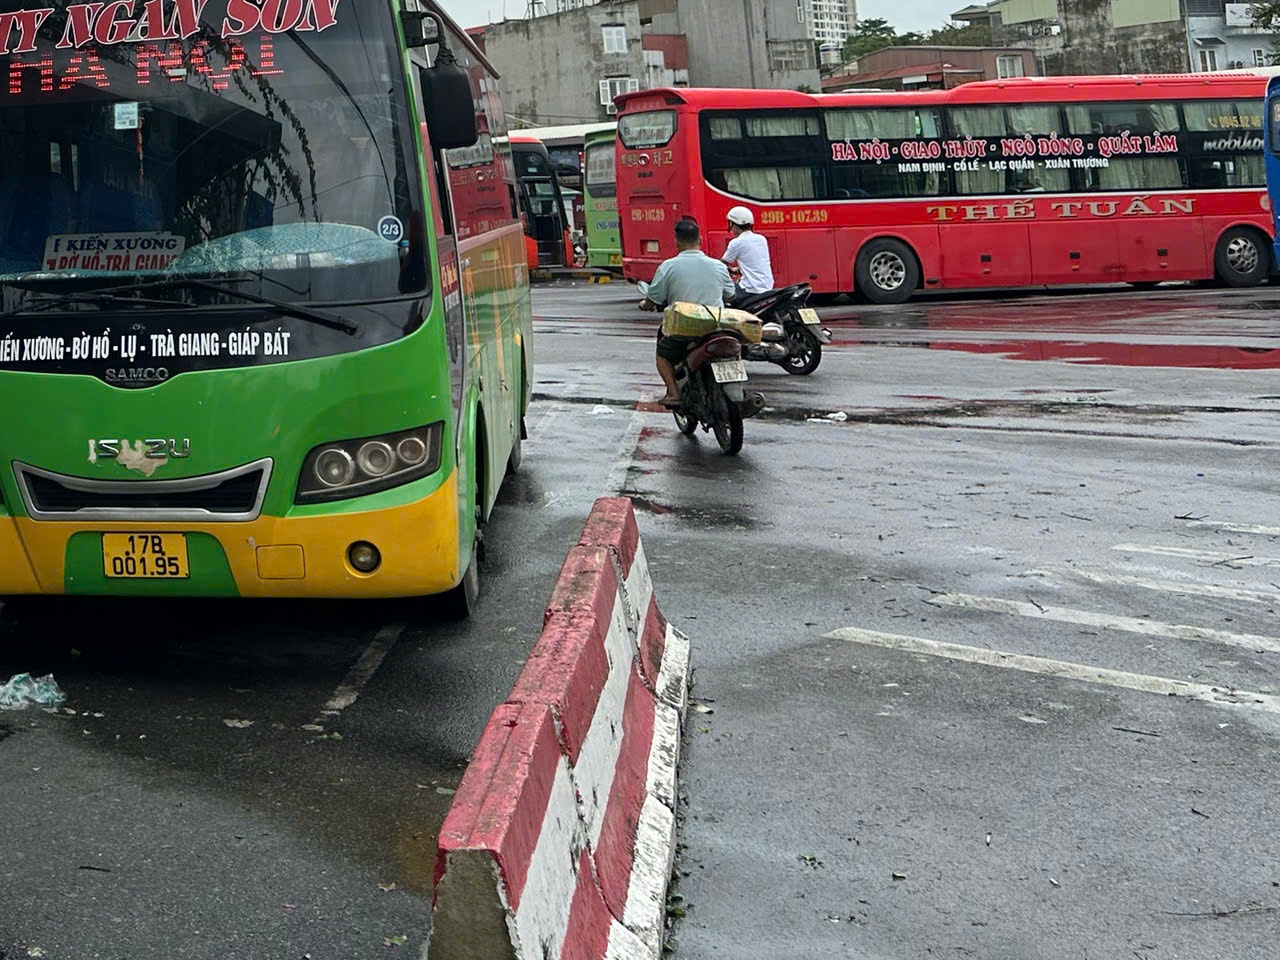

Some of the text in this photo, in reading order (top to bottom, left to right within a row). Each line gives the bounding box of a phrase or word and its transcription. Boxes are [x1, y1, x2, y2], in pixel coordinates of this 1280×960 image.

[832, 138, 857, 161] HÀ
[859, 138, 890, 165] NỘI
[900, 140, 941, 159] GIAO
[1001, 134, 1036, 157] NGÔ
[1098, 131, 1143, 158] QUẤT
[1145, 131, 1178, 153] LÂM
[898, 162, 920, 173] NAM
[1045, 157, 1070, 169] XUÂN
[927, 195, 1197, 221] THẾ TUẤN
[382, 224, 399, 235] 2/3
[67, 236, 107, 252] KIẾN
[113, 232, 178, 249] XƯƠNG
[92, 327, 111, 359] HỒ
[120, 335, 137, 362] LỤ
[150, 329, 175, 357] TRÀ
[263, 327, 291, 356] BÁT
[105, 367, 168, 382] SAMCO
[88, 438, 190, 460] ISUZU
[127, 535, 163, 554] 17B
[112, 556, 180, 576] 001.95
